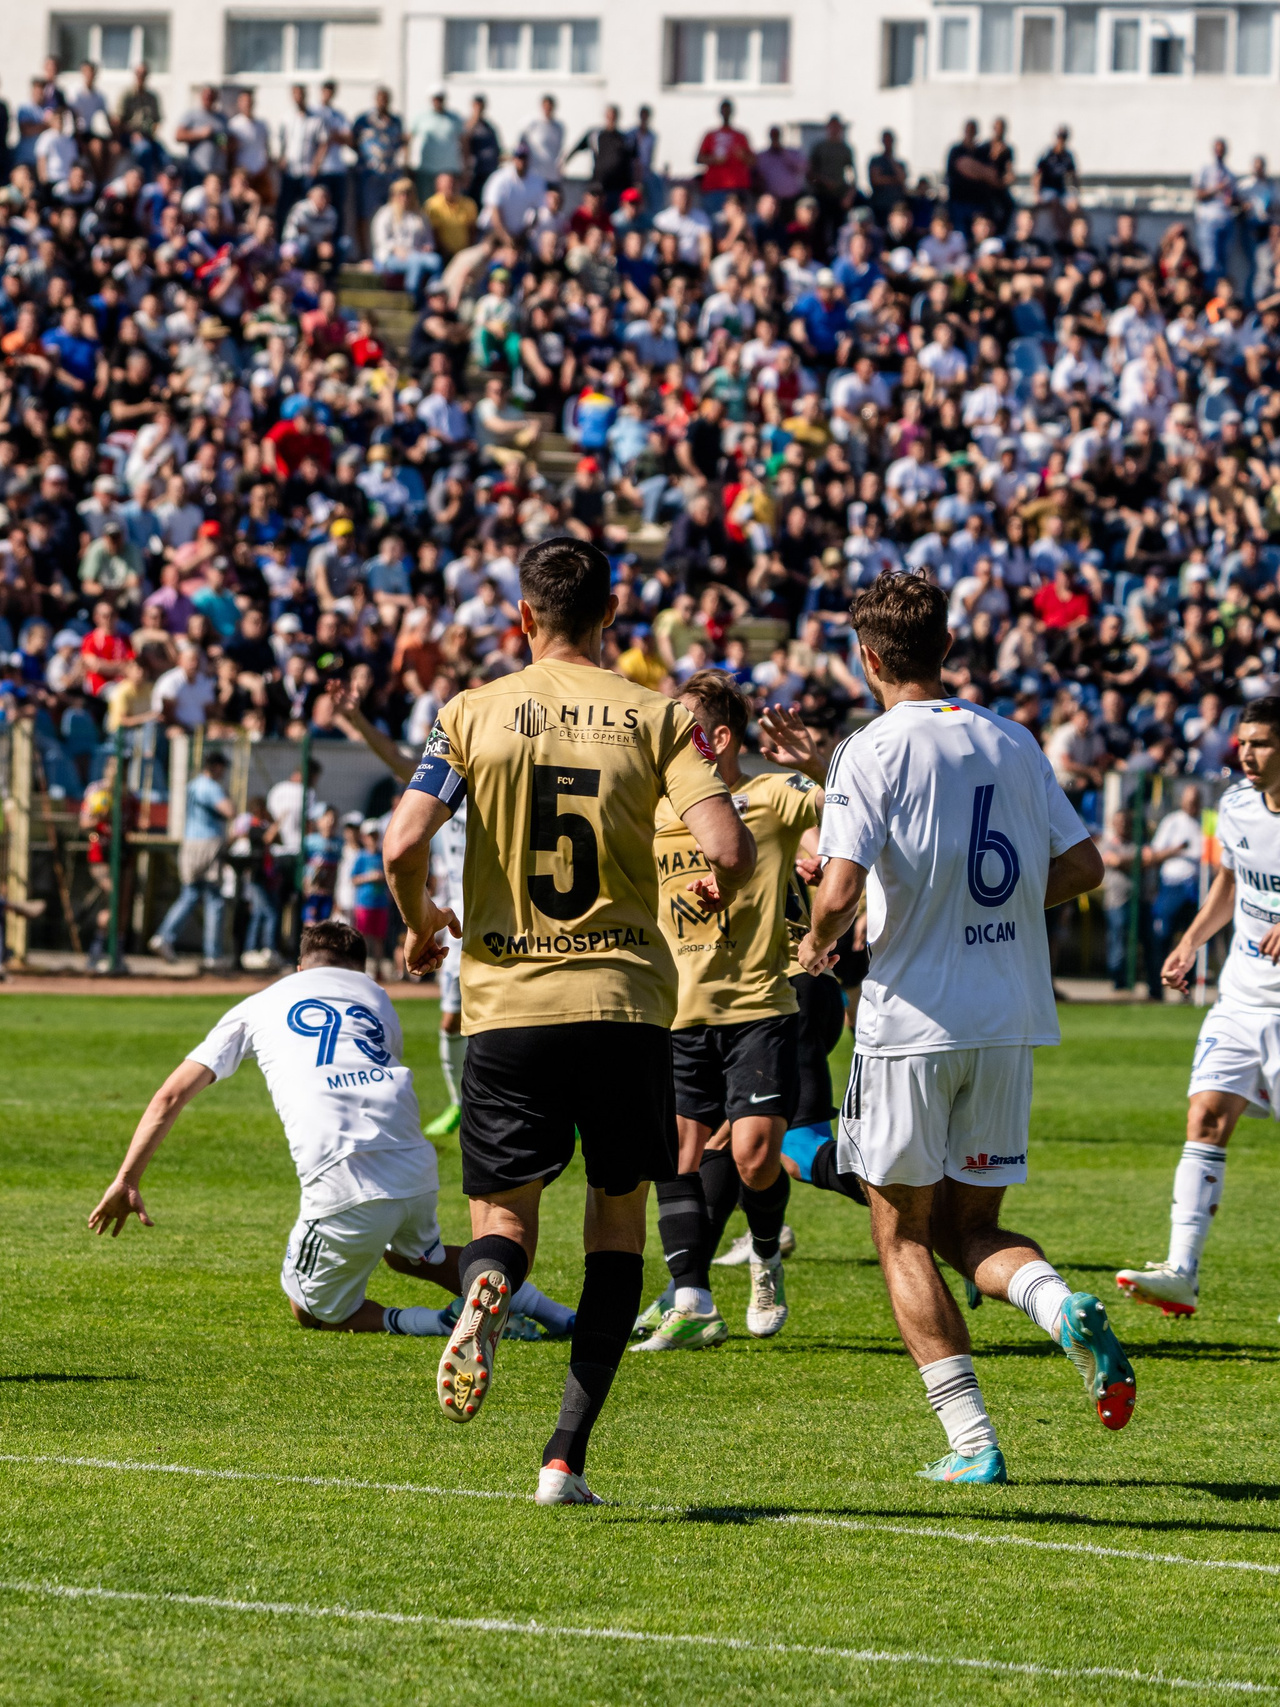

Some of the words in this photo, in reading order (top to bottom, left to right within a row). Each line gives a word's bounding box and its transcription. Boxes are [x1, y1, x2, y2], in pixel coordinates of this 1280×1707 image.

[560, 705, 639, 729] HILS
[559, 729, 637, 744] DEVELOPMENT
[557, 776, 575, 785] FCV
[527, 764, 601, 921] 5
[968, 784, 1021, 907] 6
[506, 936, 529, 954] M
[536, 927, 650, 954] HOSPITAL
[725, 940, 738, 949] TV
[965, 921, 1016, 945] DICAN
[287, 998, 392, 1067] 93
[988, 1153, 1025, 1166] Smart
